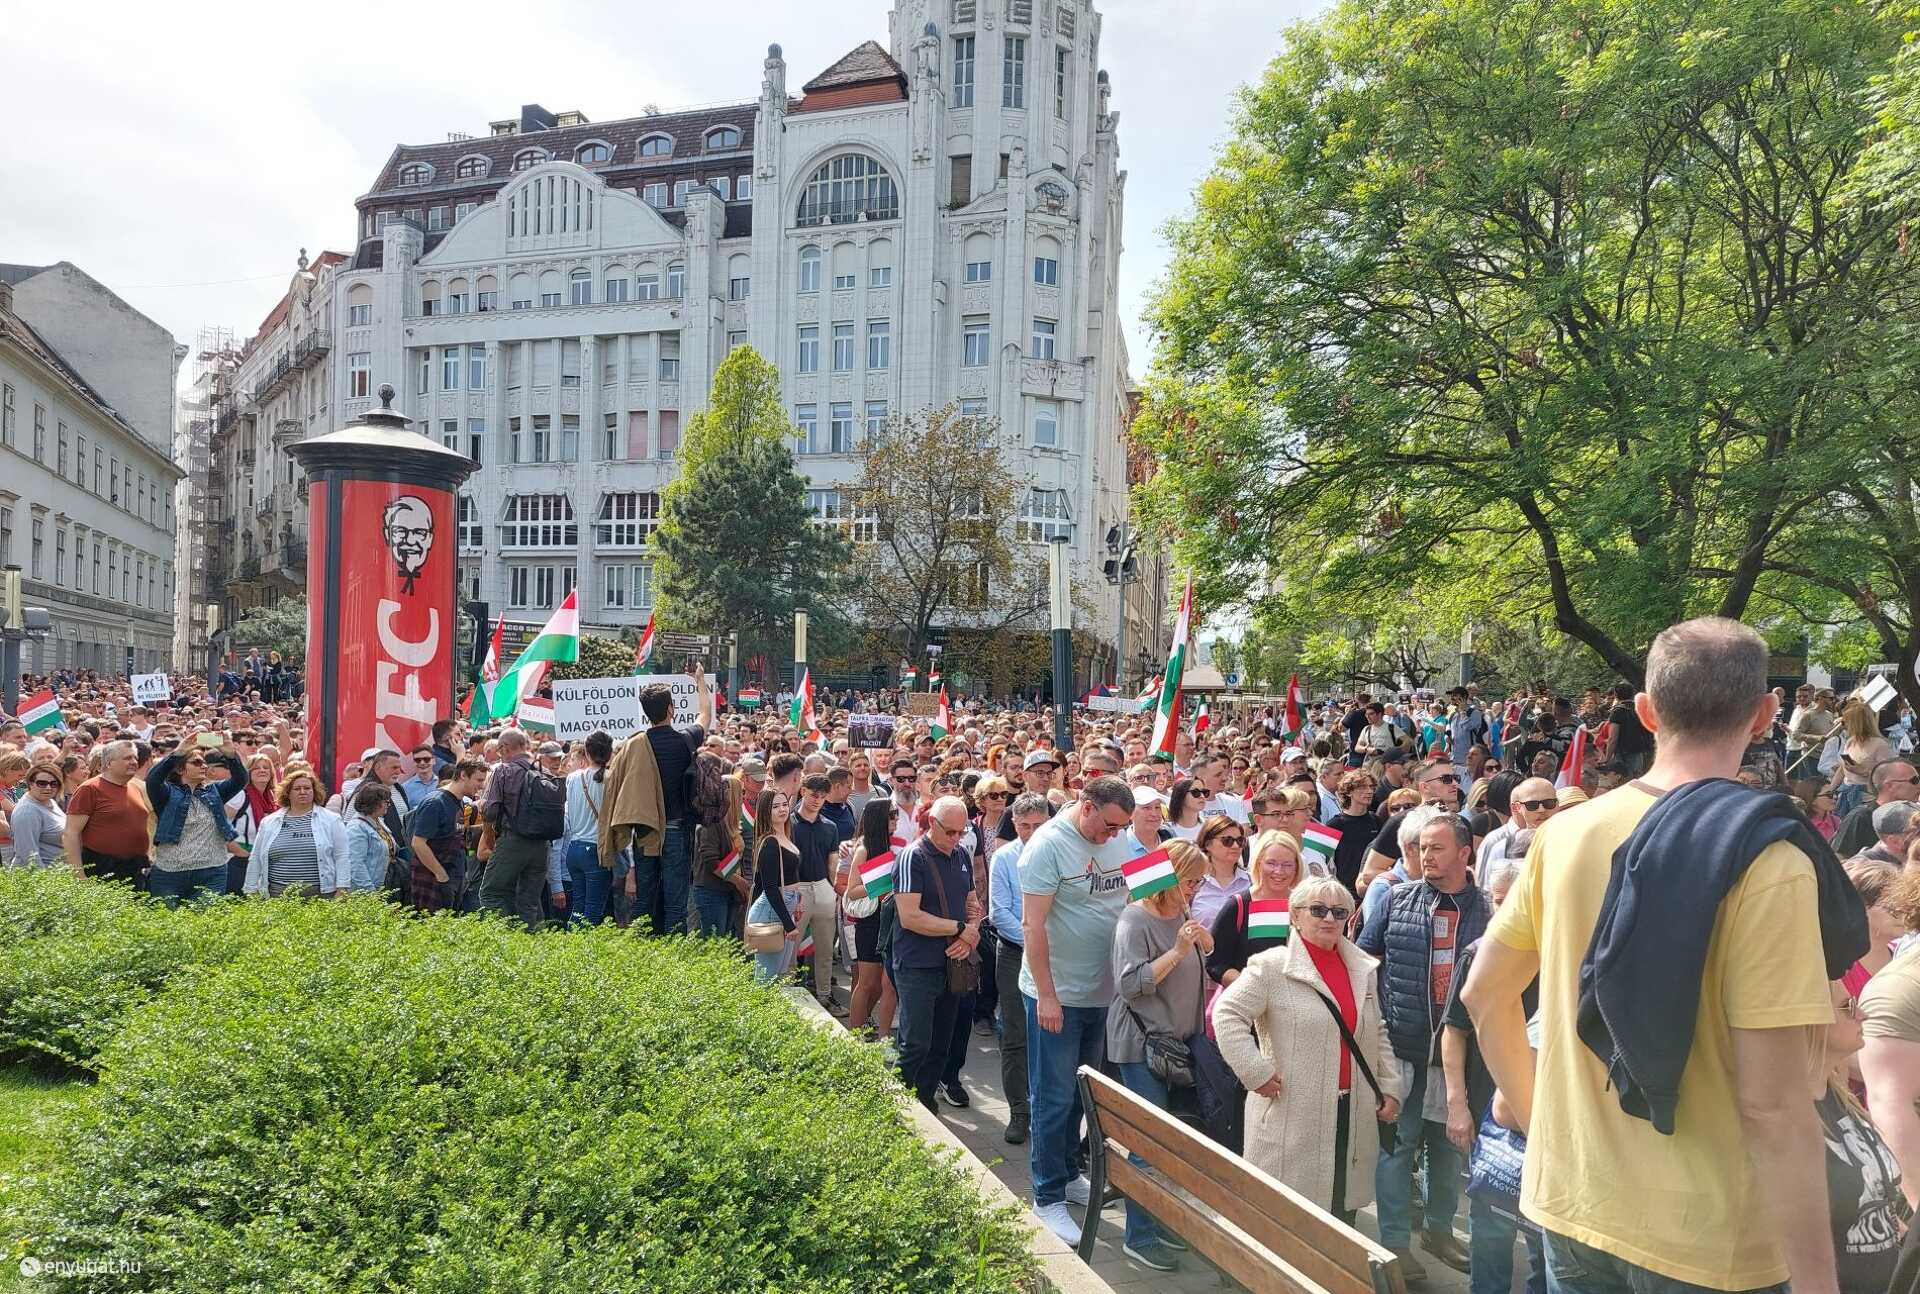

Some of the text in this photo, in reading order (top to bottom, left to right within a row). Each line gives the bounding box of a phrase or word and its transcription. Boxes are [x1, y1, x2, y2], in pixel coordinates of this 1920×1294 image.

[556, 686, 635, 702] KÜLFÖLDÖN
[585, 703, 609, 716] ÉLŐ
[560, 718, 634, 733] MAGYAROK
[1086, 869, 1127, 895] Miam
[1847, 1205, 1894, 1244] MICK
